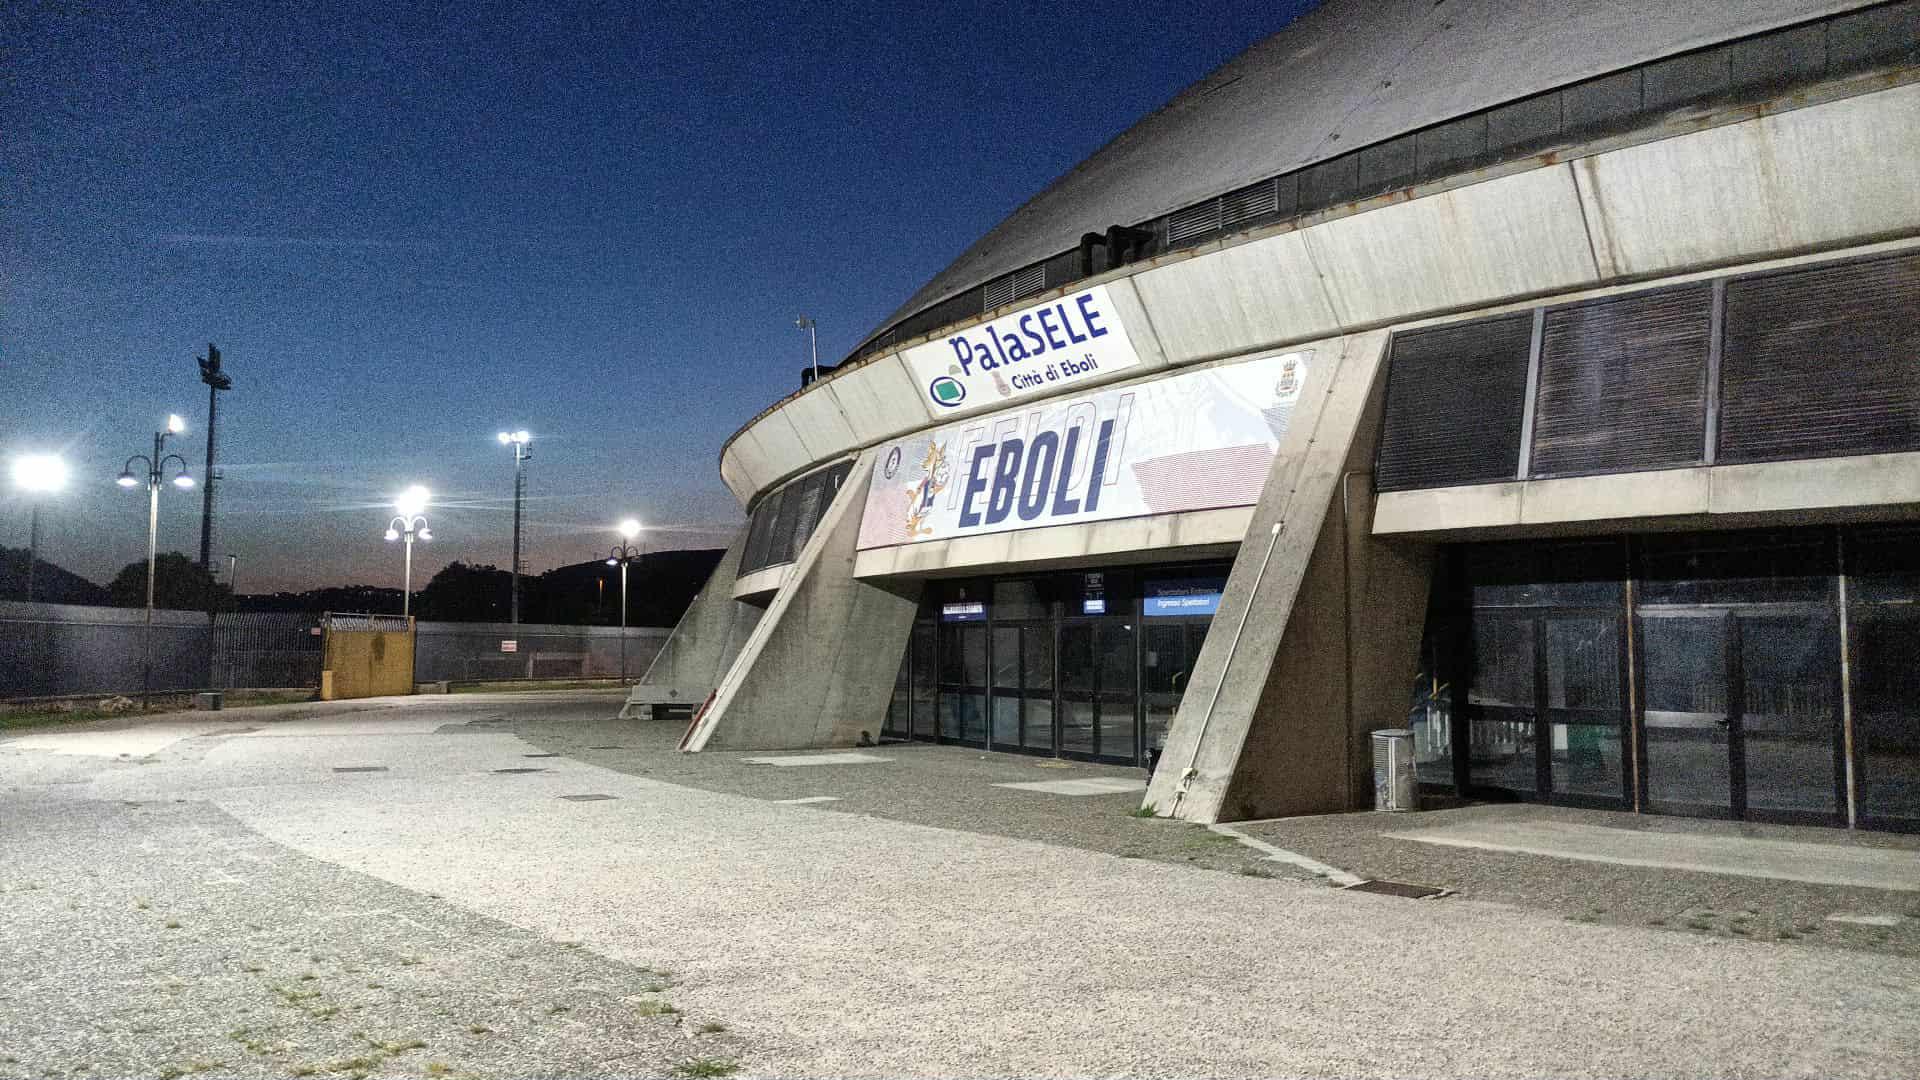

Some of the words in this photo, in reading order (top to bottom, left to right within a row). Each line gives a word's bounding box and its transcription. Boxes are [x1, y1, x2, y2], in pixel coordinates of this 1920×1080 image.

[949, 293, 1108, 376] PalaSELE
[1011, 369, 1043, 390] Città
[1045, 362, 1060, 381] di
[1060, 353, 1098, 377] Eboli
[958, 418, 1115, 528] EBOLI
